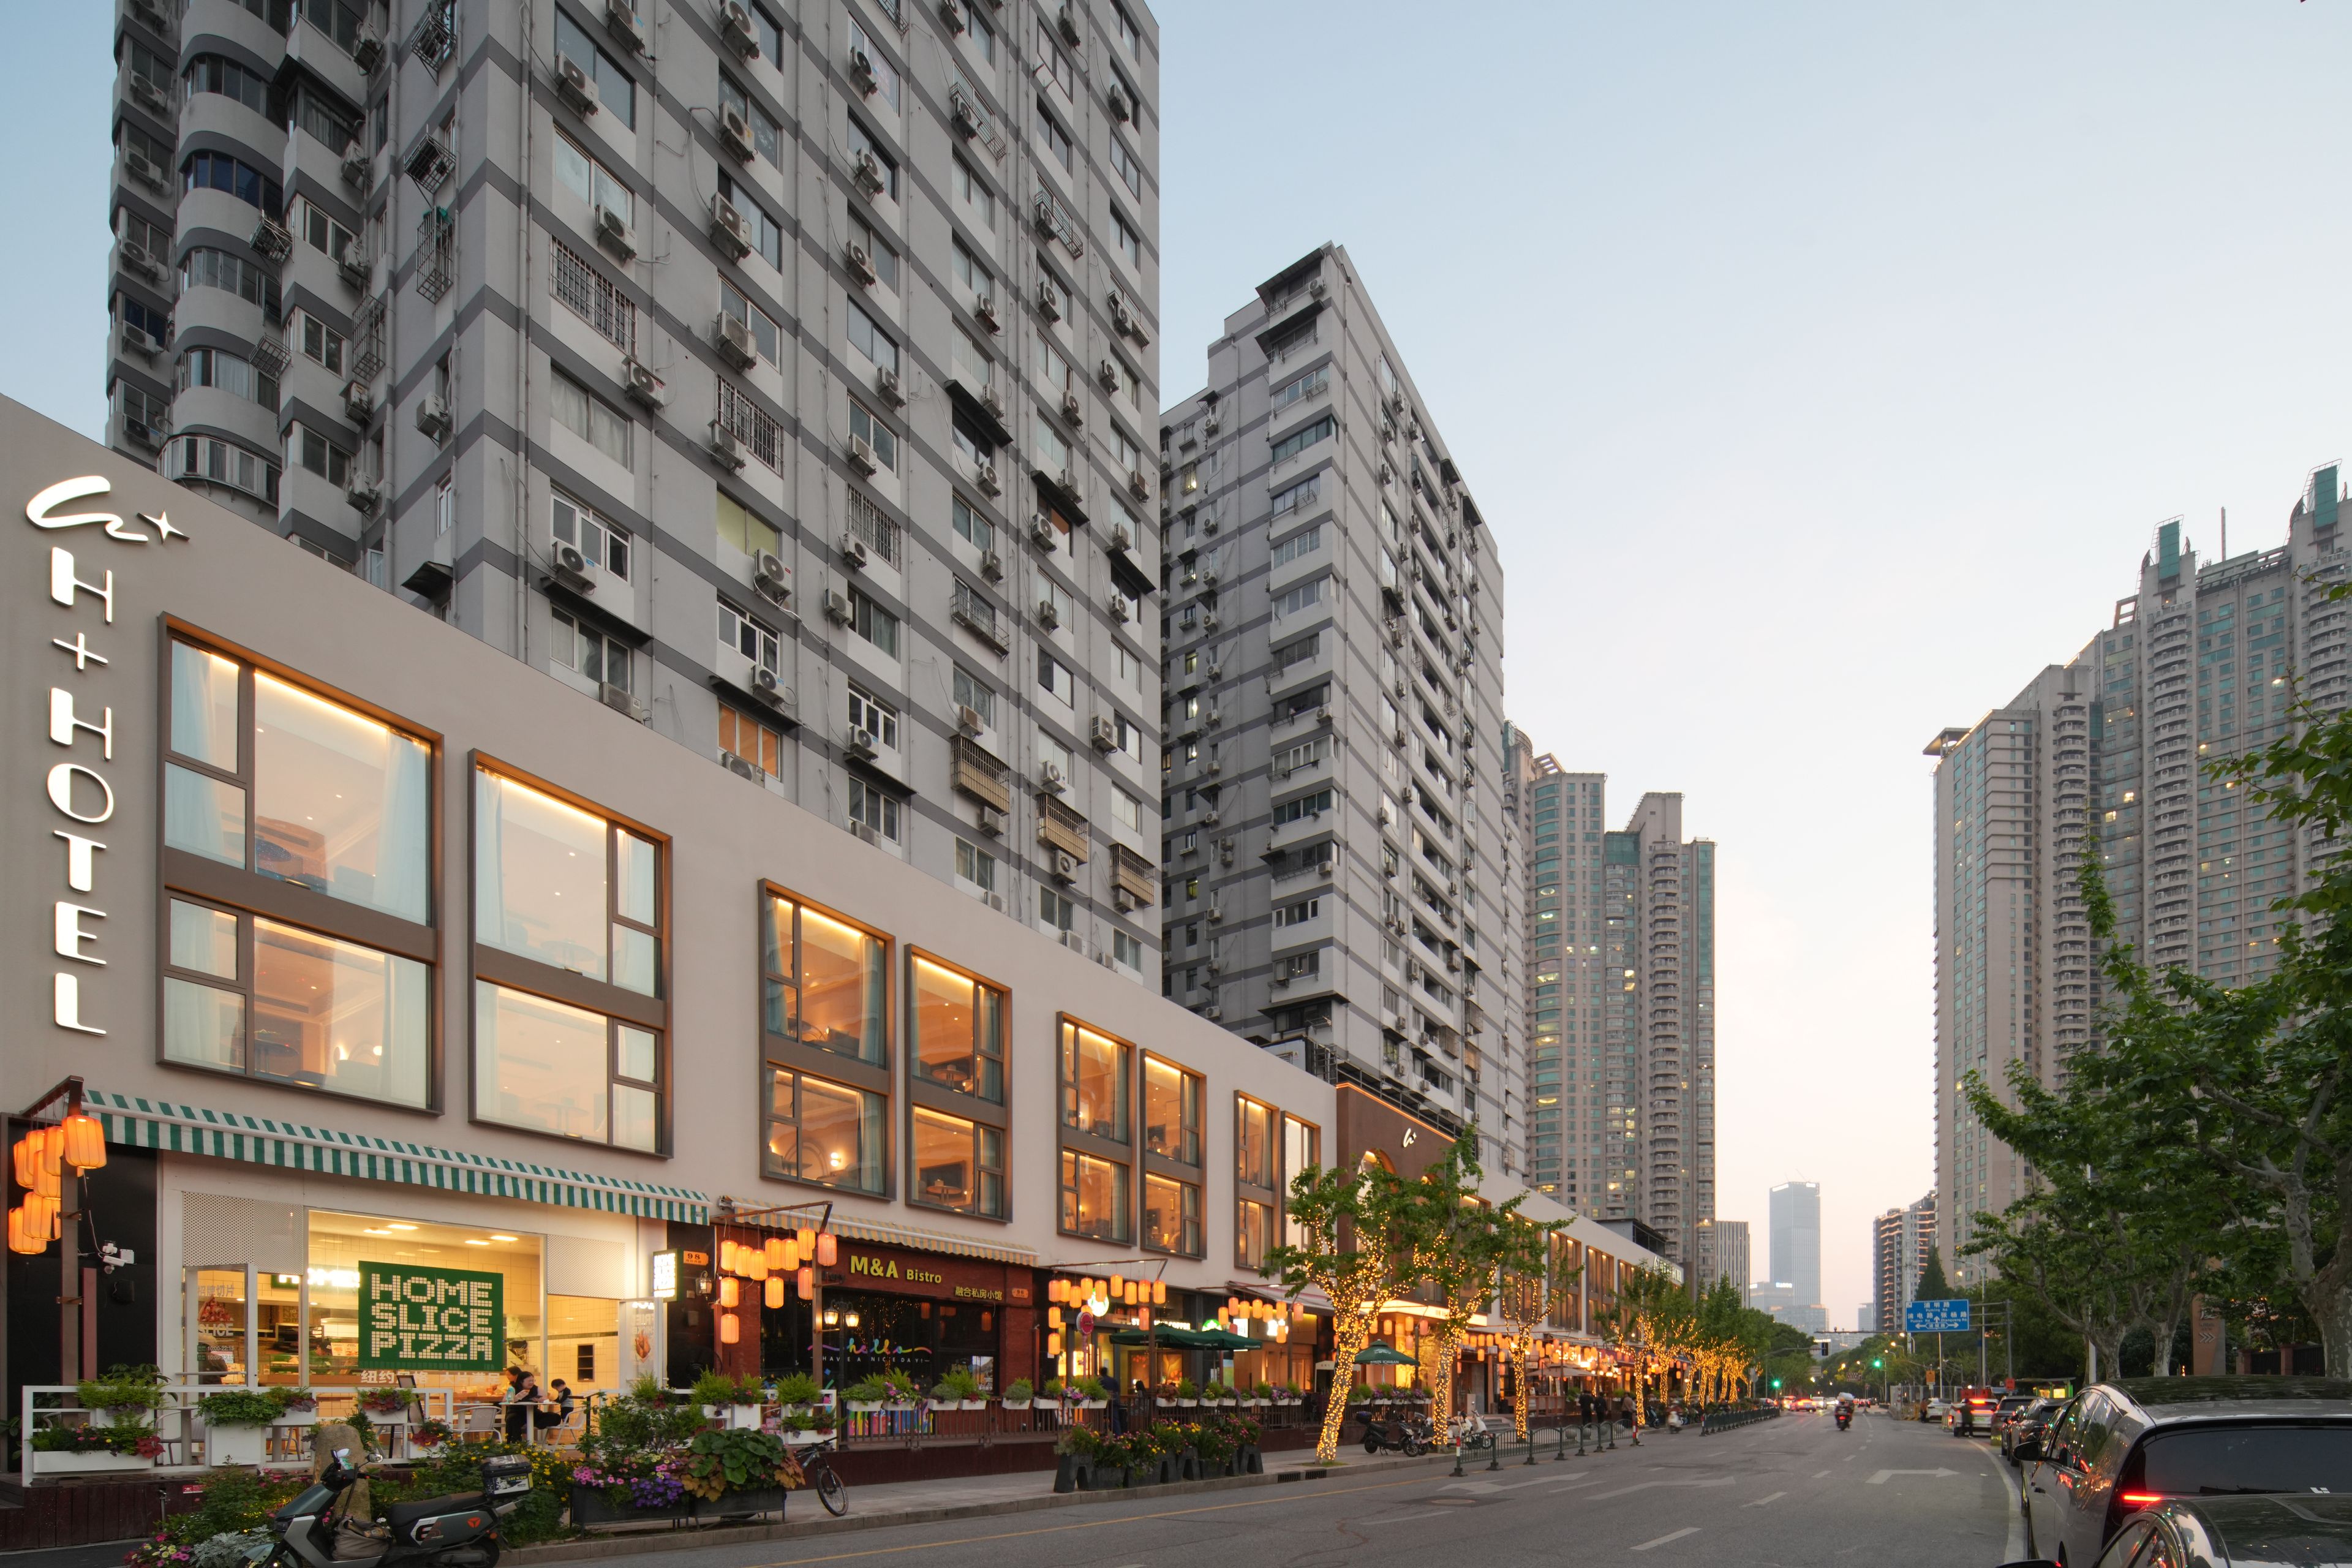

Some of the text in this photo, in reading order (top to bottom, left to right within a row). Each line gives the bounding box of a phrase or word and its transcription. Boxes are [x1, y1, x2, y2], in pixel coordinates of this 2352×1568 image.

[850, 1254, 899, 1279] M&A
[906, 1268, 943, 1284] Bistro
[371, 1273, 493, 1307] HOME
[954, 1286, 1003, 1302] 融合私房小馆
[198, 1323, 234, 1336] SLICE
[371, 1302, 493, 1335] SLICE
[371, 1330, 493, 1362] PIZZA
